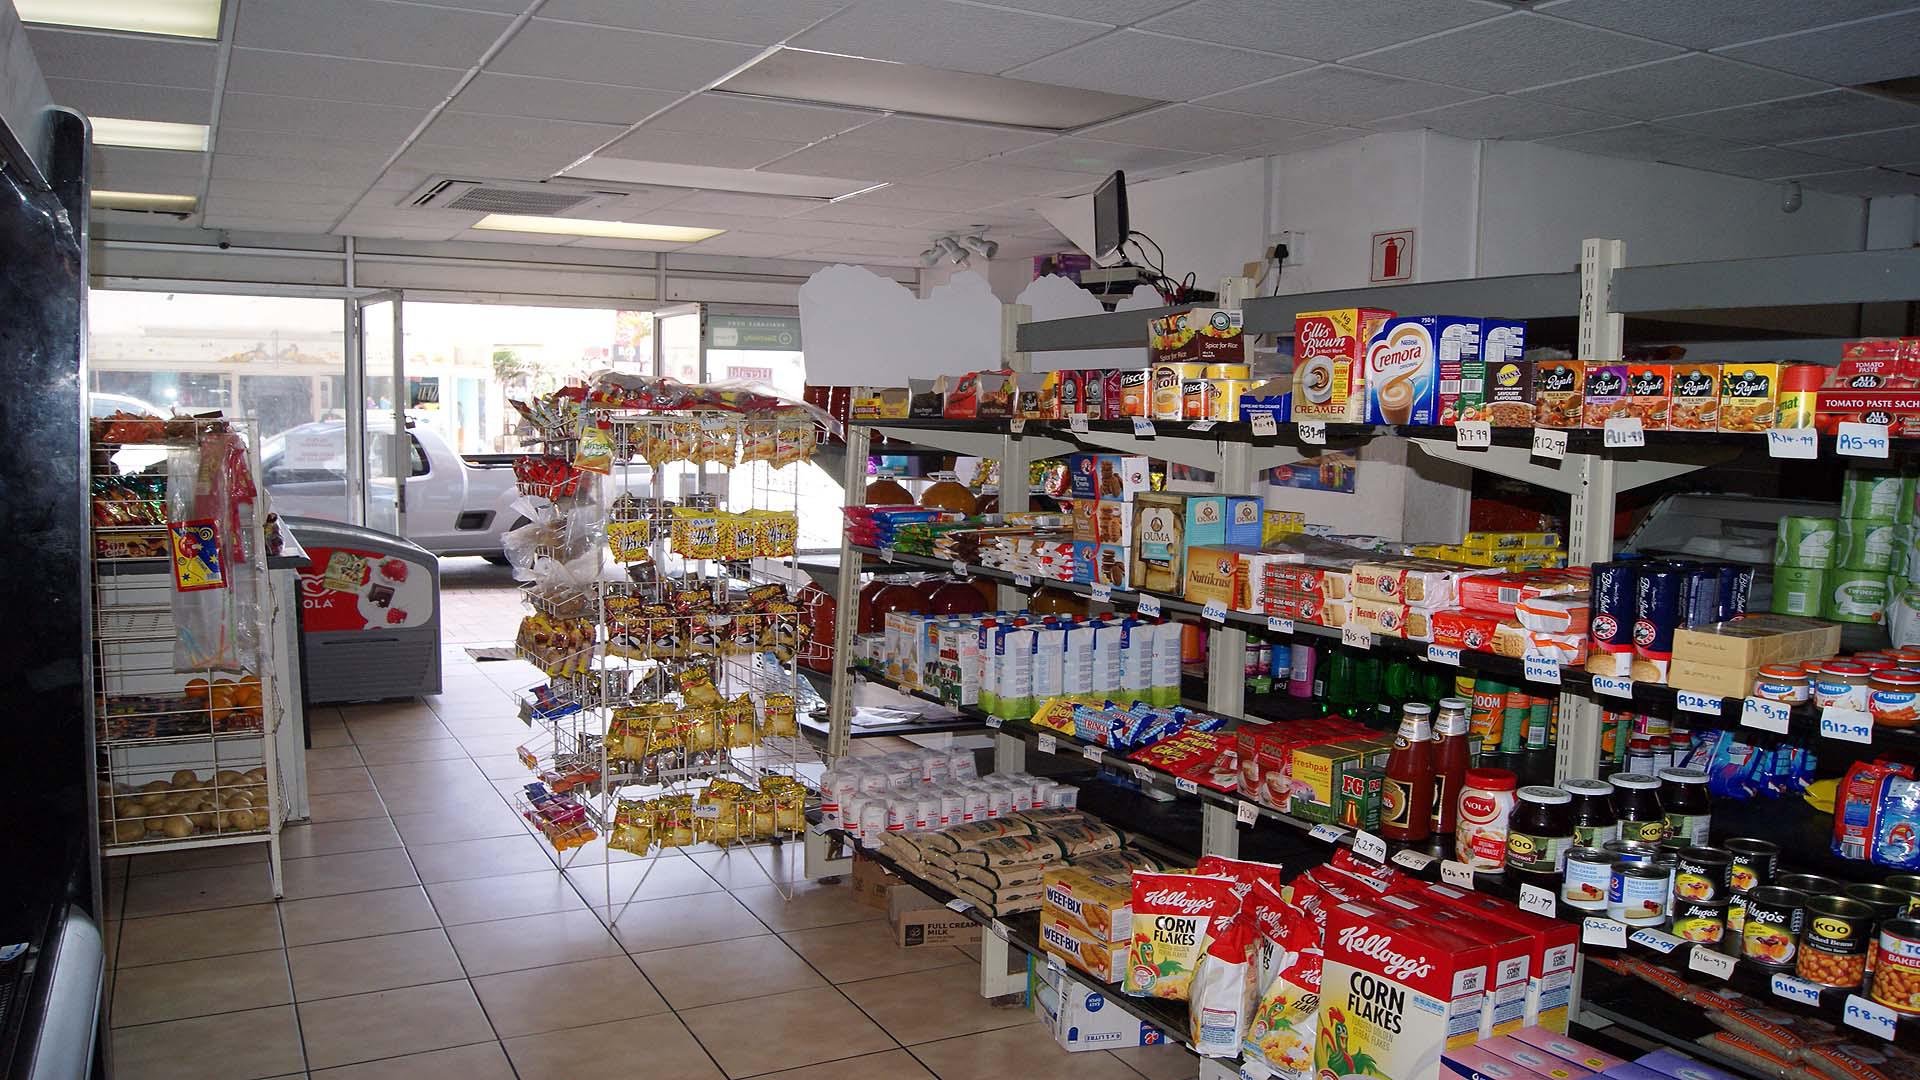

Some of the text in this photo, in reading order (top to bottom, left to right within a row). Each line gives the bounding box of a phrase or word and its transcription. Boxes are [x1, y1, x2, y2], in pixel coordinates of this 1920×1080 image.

[1301, 321, 1330, 344] Ellis
[1301, 338, 1345, 358] Brown
[1371, 345, 1421, 372] Cremora
[1547, 374, 1572, 391] Rajah
[1594, 380, 1620, 395] Rajah
[1635, 380, 1662, 395] Rajah
[1682, 380, 1710, 395] Rajah
[1734, 379, 1766, 396] Rajah
[1295, 406, 1345, 414] CREAMER
[1866, 400, 1892, 408] PASTE
[1840, 434, 1885, 449] R5-99
[1144, 533, 1170, 542] OUMA
[1356, 574, 1375, 586] Tennis
[1357, 607, 1377, 619] Tennis
[1594, 678, 1631, 692] R10-99
[1818, 682, 1849, 693] PURITY
[1878, 693, 1912, 701] PURITY
[1822, 720, 1869, 737] R12-99
[1294, 758, 1329, 773] Freshpak
[1342, 774, 1364, 796] FG
[1465, 801, 1492, 812] NOLA
[1678, 860, 1705, 875] Hugo's
[1046, 888, 1082, 915] WEET-BIX
[1145, 889, 1216, 914] Kellogg's
[1684, 905, 1718, 919] Hugo's
[1748, 902, 1785, 924] Hugo's
[1155, 916, 1196, 934] CORN
[1815, 921, 1848, 934] KOO
[1044, 926, 1080, 954] WEET-BIX
[1154, 931, 1195, 946] FLAKES
[1808, 933, 1829, 944] Baked
[1338, 925, 1432, 980] Kellogg's
[1506, 967, 1520, 975] CORN
[1463, 977, 1477, 986] CORN
[1350, 971, 1405, 1014] CORN
[1775, 981, 1818, 1000] R10-99
[1347, 998, 1401, 1034] FLAKES
